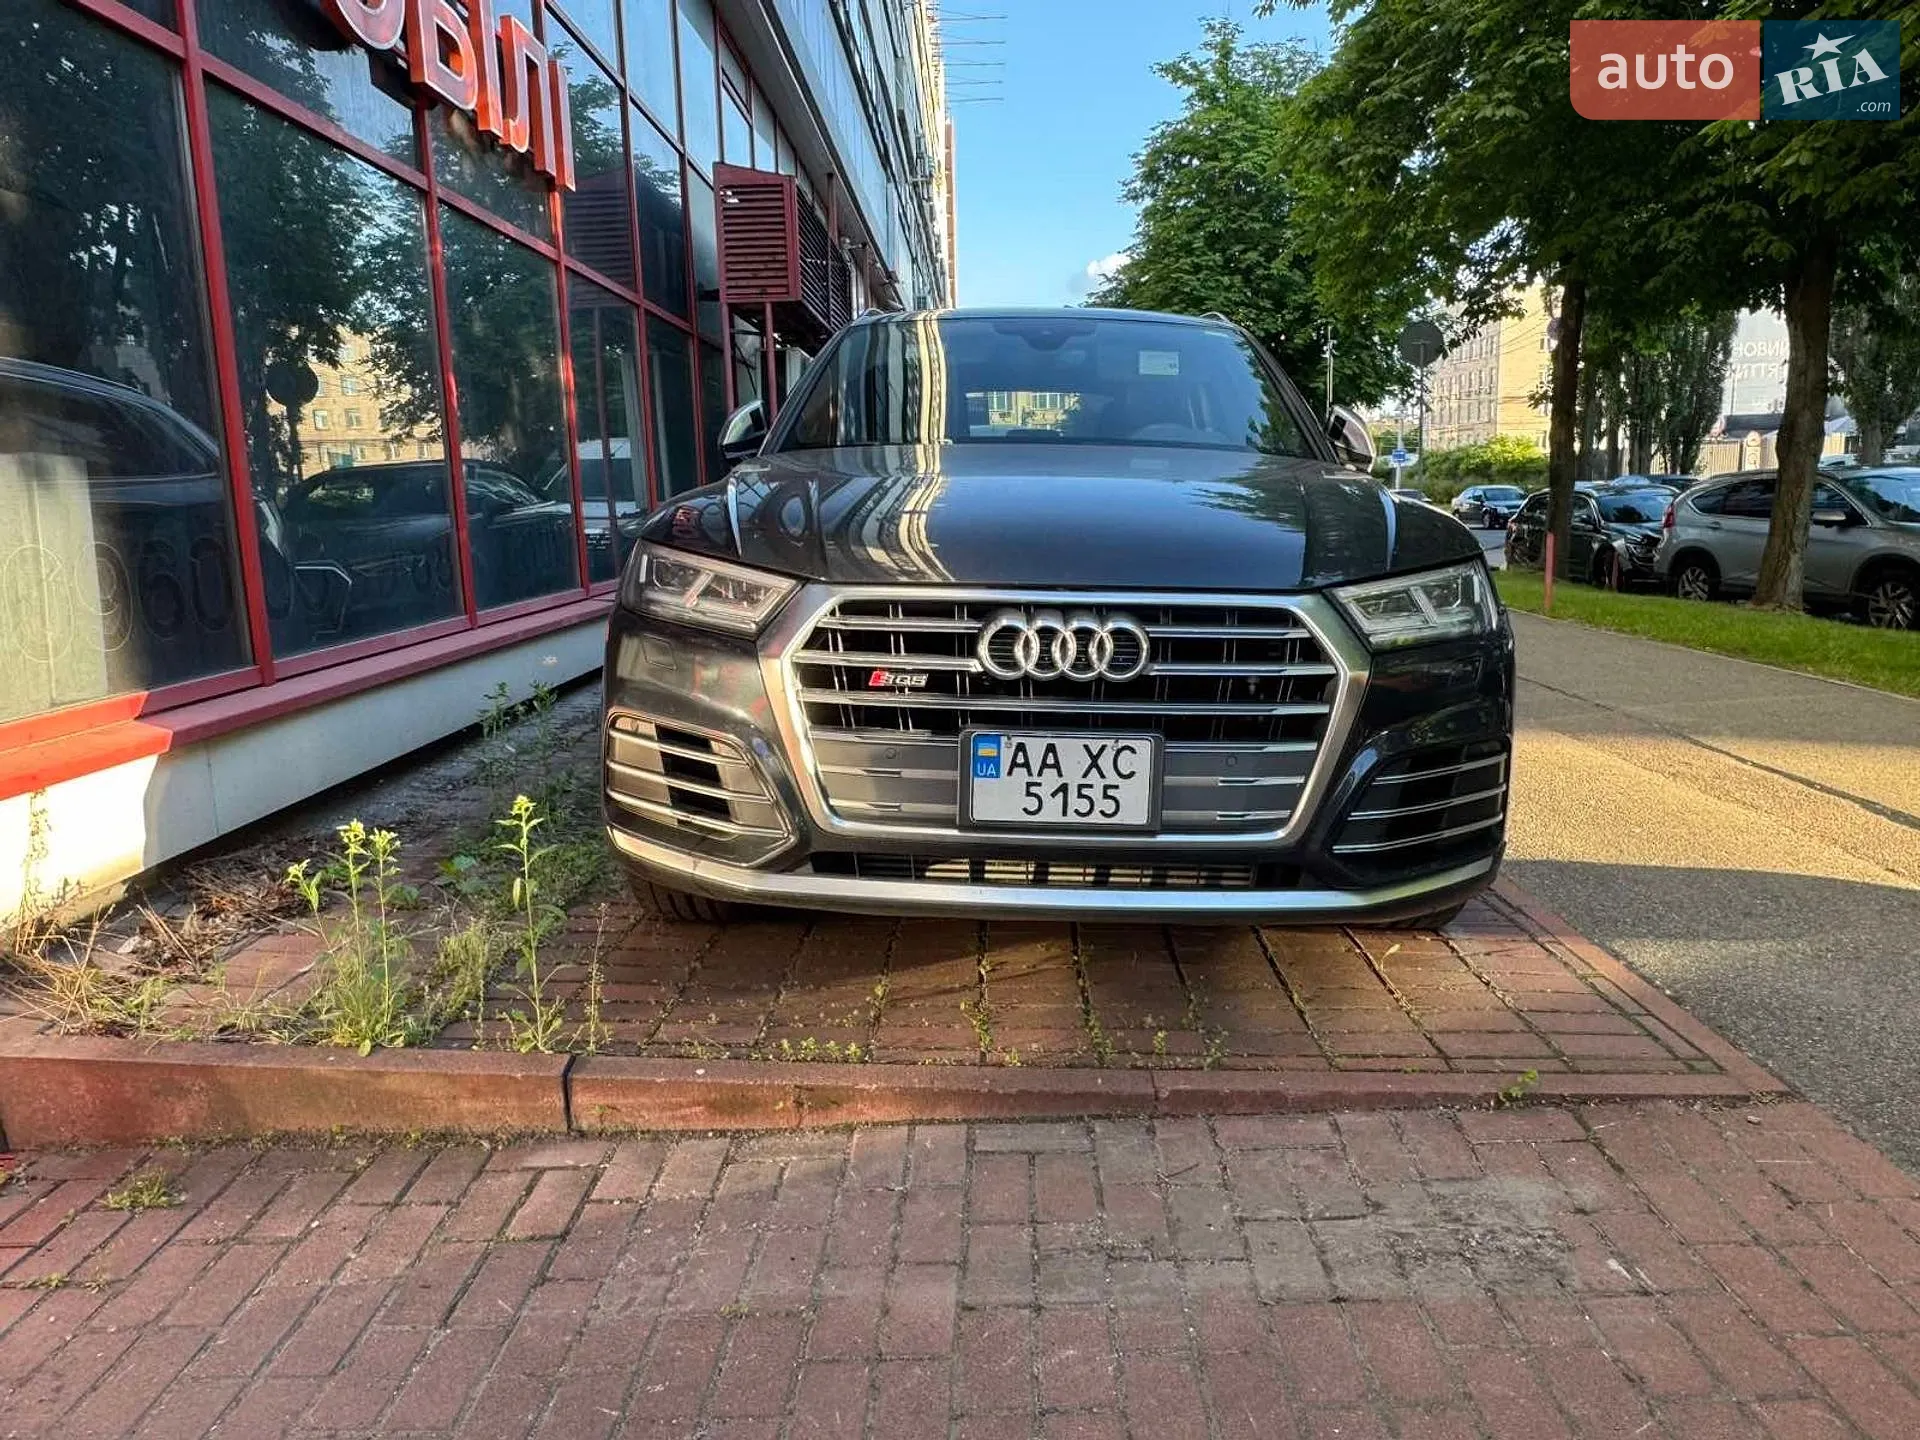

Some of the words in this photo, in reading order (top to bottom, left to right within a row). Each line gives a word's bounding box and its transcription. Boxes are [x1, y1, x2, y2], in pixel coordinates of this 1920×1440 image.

[977, 762, 997, 776] UA
[1006, 741, 1063, 778] AA
[1081, 743, 1137, 780] XC
[1022, 781, 1121, 819] 5155
